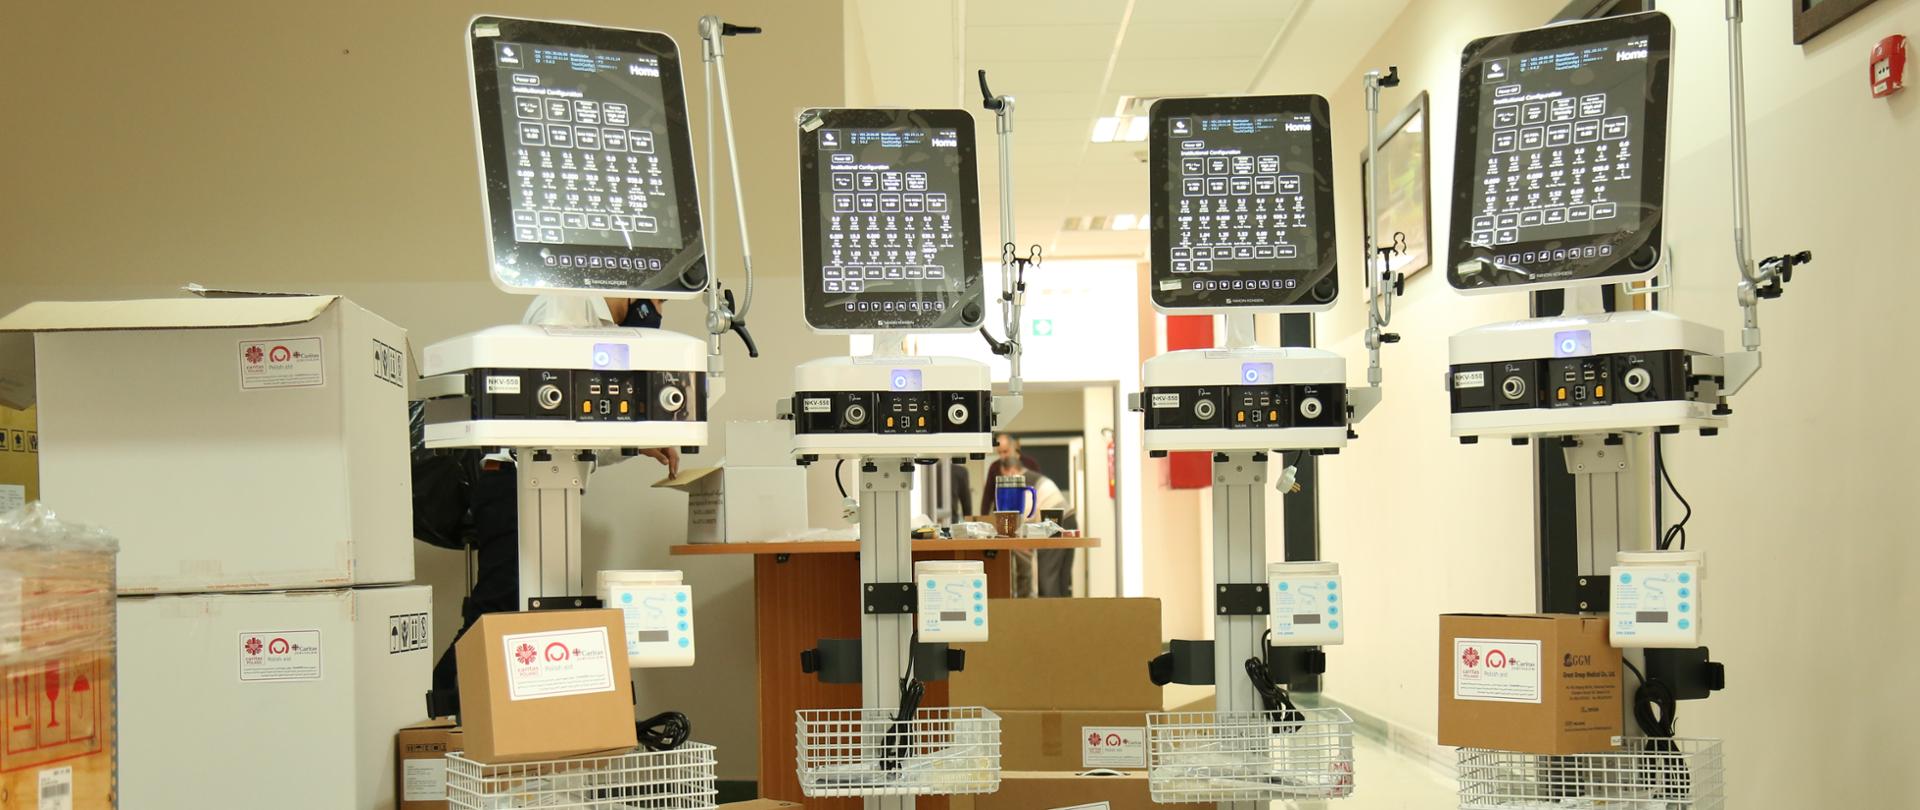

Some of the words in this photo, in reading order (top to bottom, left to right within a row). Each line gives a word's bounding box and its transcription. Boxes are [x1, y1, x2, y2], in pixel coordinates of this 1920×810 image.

[1616, 50, 1647, 62] Home
[629, 65, 659, 78] Home
[512, 86, 546, 94] Institutional
[546, 88, 584, 98] Configuration
[1494, 96, 1525, 105] Institutional
[1526, 91, 1562, 101] Configuration
[1285, 123, 1311, 132] Home
[932, 138, 957, 147] Home
[1572, 655, 1591, 665] GGM
